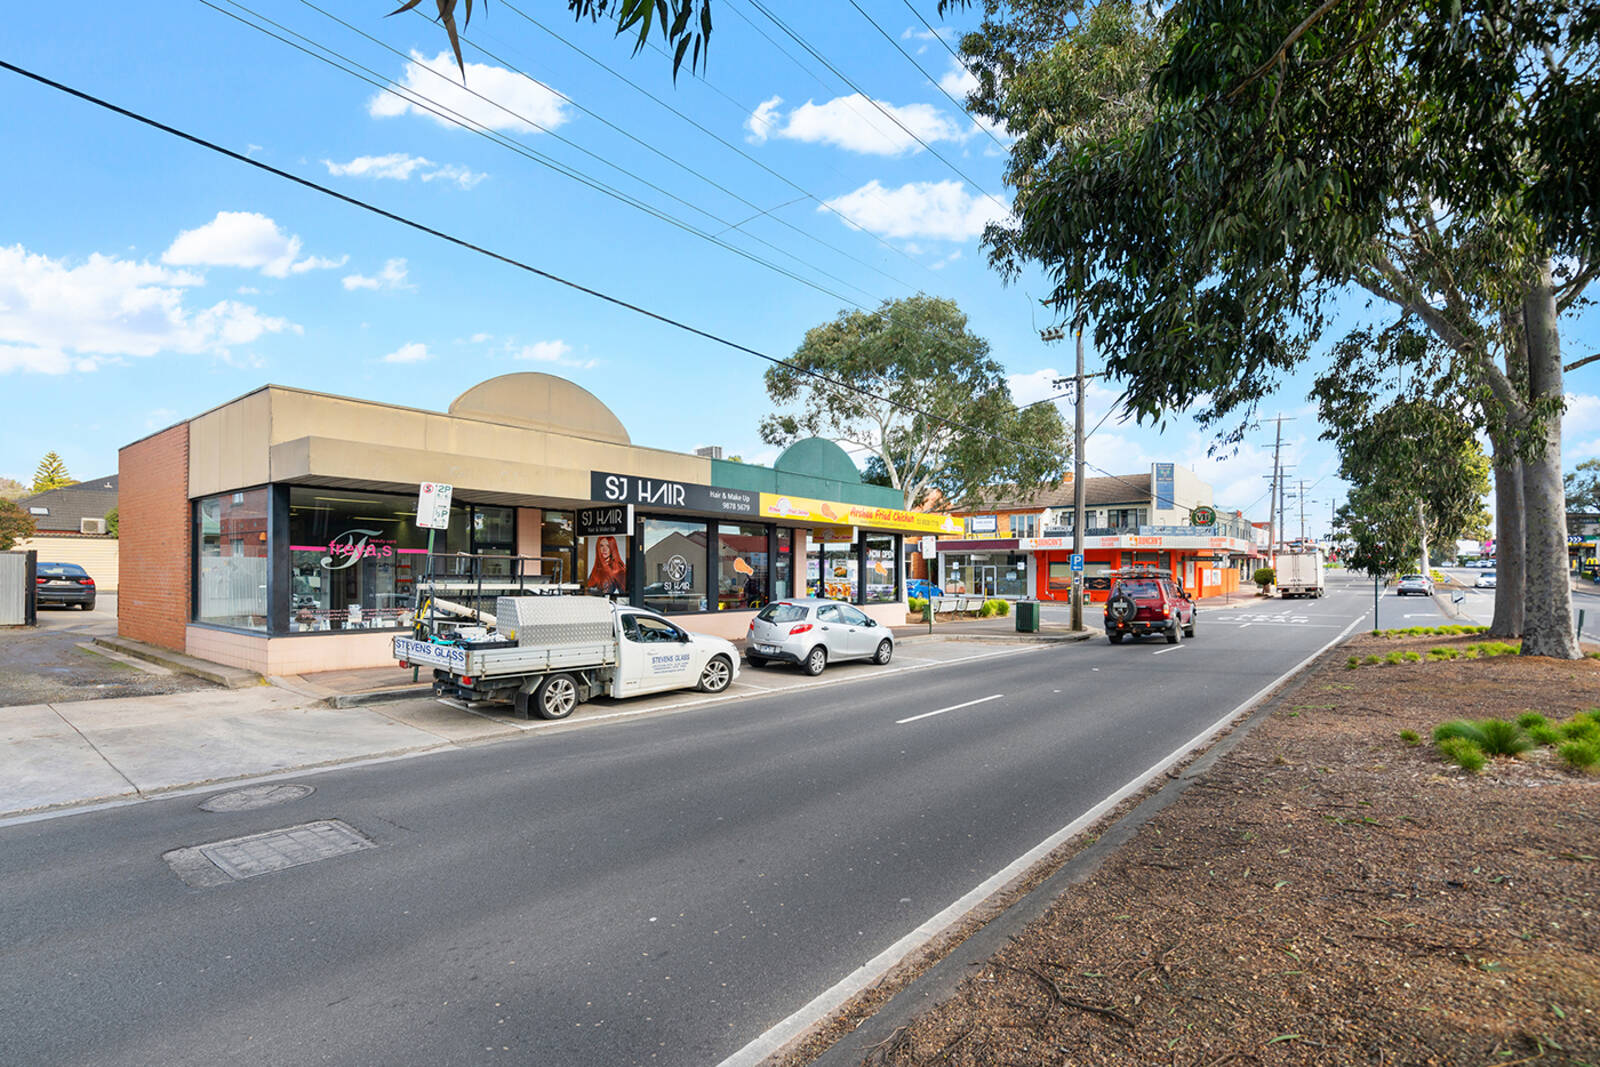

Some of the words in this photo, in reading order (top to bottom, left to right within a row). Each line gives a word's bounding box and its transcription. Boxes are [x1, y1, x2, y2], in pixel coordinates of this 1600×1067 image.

[438, 485, 451, 493] 2P
[605, 476, 628, 500] SJ
[638, 479, 685, 506] HAIR
[722, 492, 727, 500] &
[582, 511, 593, 526] SJ
[596, 508, 623, 525] HAIR
[1074, 555, 1082, 565] P
[664, 582, 672, 590] SJ
[396, 639, 432, 655] STEVENS
[434, 647, 465, 661] GLASS
